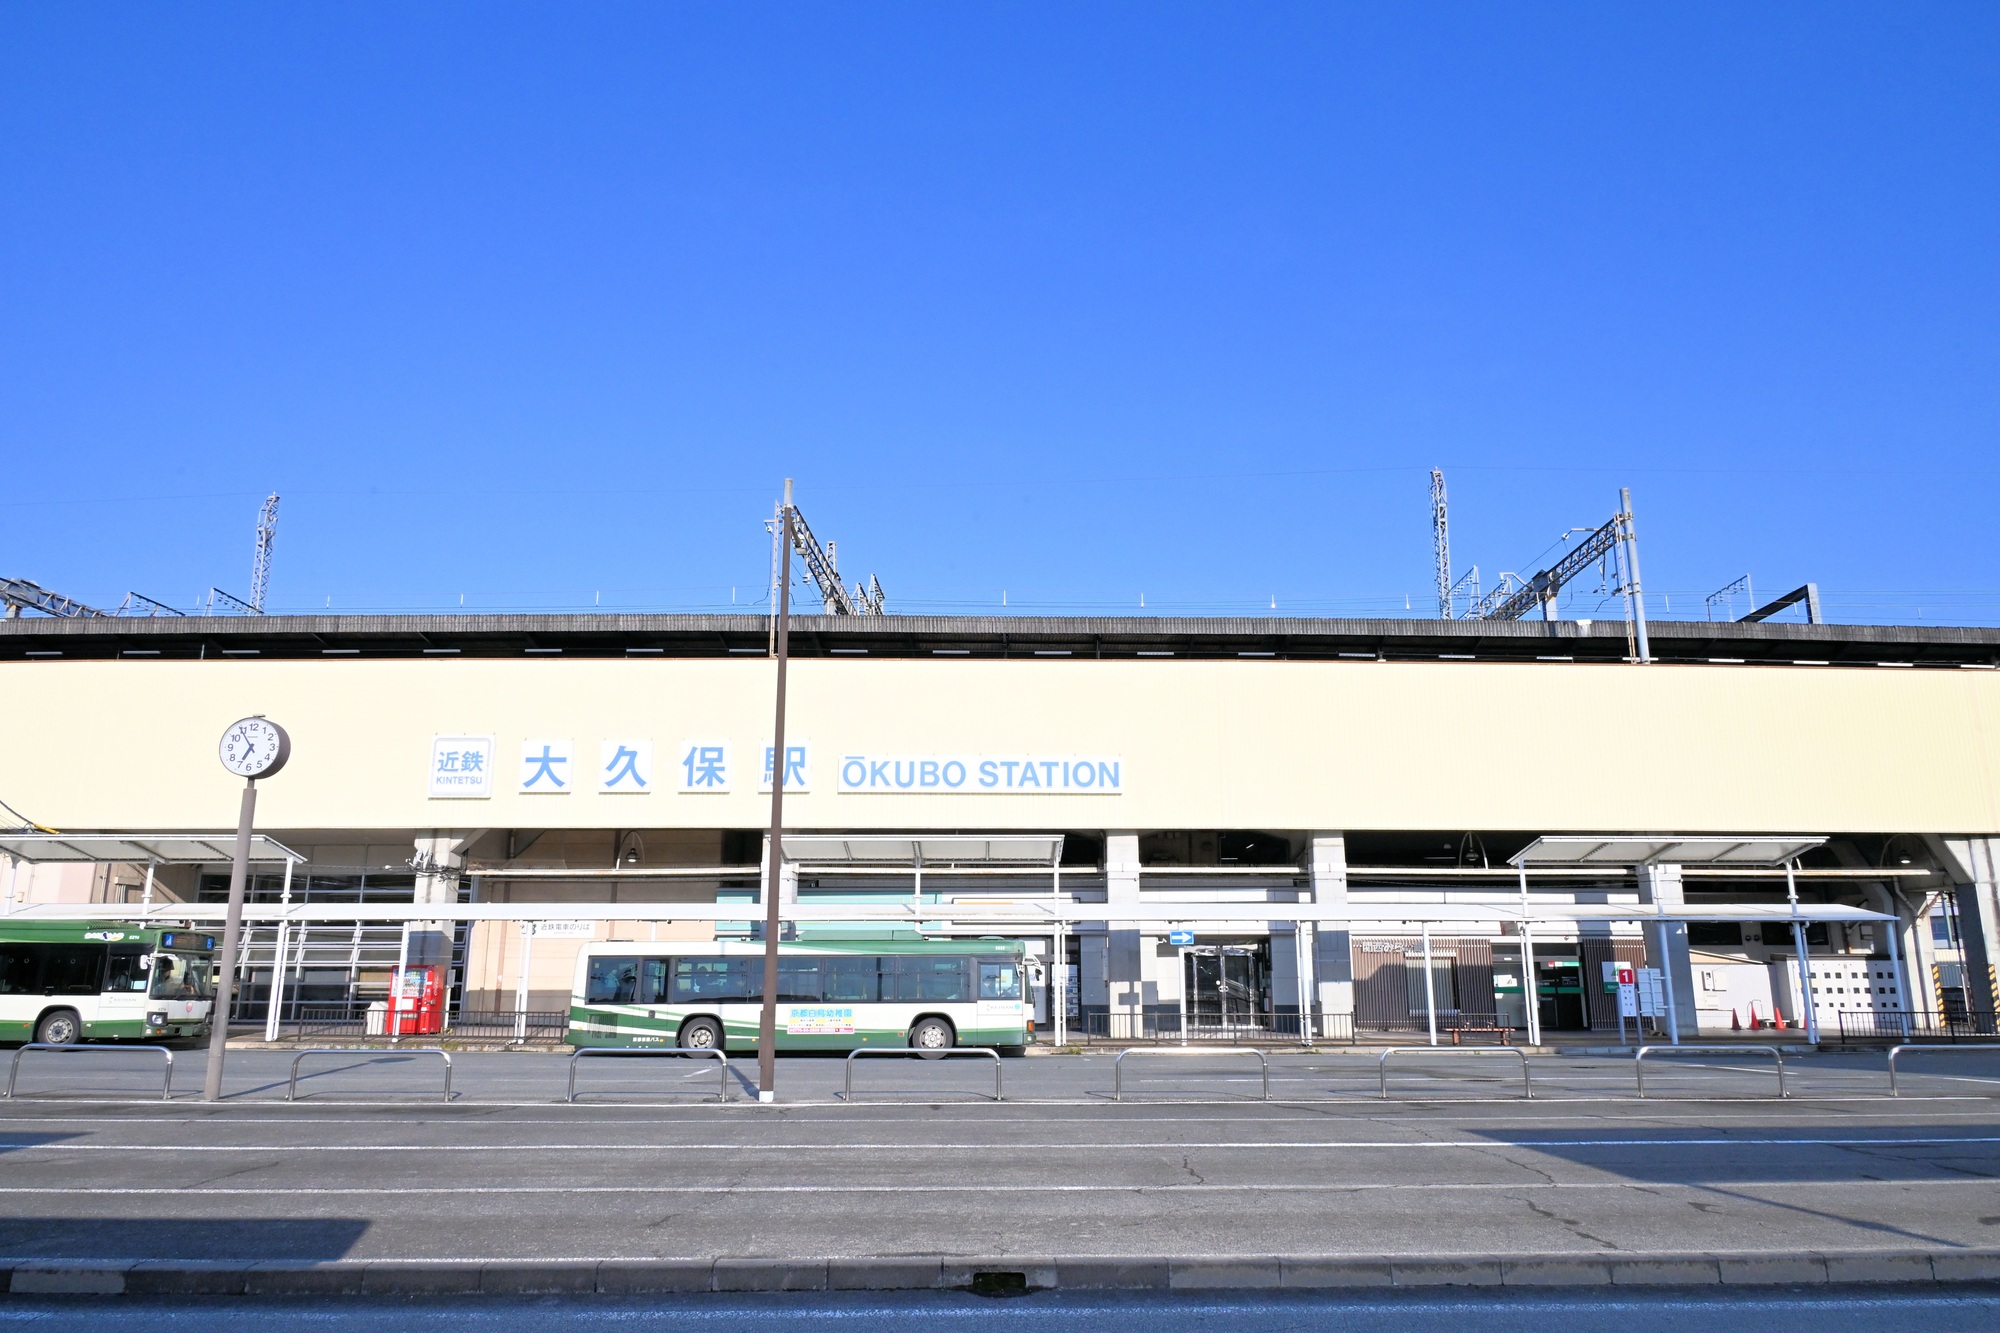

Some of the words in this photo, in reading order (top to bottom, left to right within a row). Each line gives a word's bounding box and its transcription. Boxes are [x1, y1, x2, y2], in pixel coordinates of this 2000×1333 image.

[249, 723, 259, 731] 12
[231, 734, 241, 742] 10
[268, 733, 274, 741] 2
[269, 743, 275, 751] 3
[265, 753, 270, 761] 4
[237, 760, 243, 768] 7
[256, 760, 262, 768] 5
[437, 751, 484, 773] 近鉄
[245, 763, 252, 771] 6
[842, 756, 967, 788] ŌKUBO
[978, 760, 1121, 788] STATION
[436, 776, 482, 785] KINTETSU
[540, 923, 590, 931] 近鉄電車のりば
[1622, 971, 1629, 982] 1
